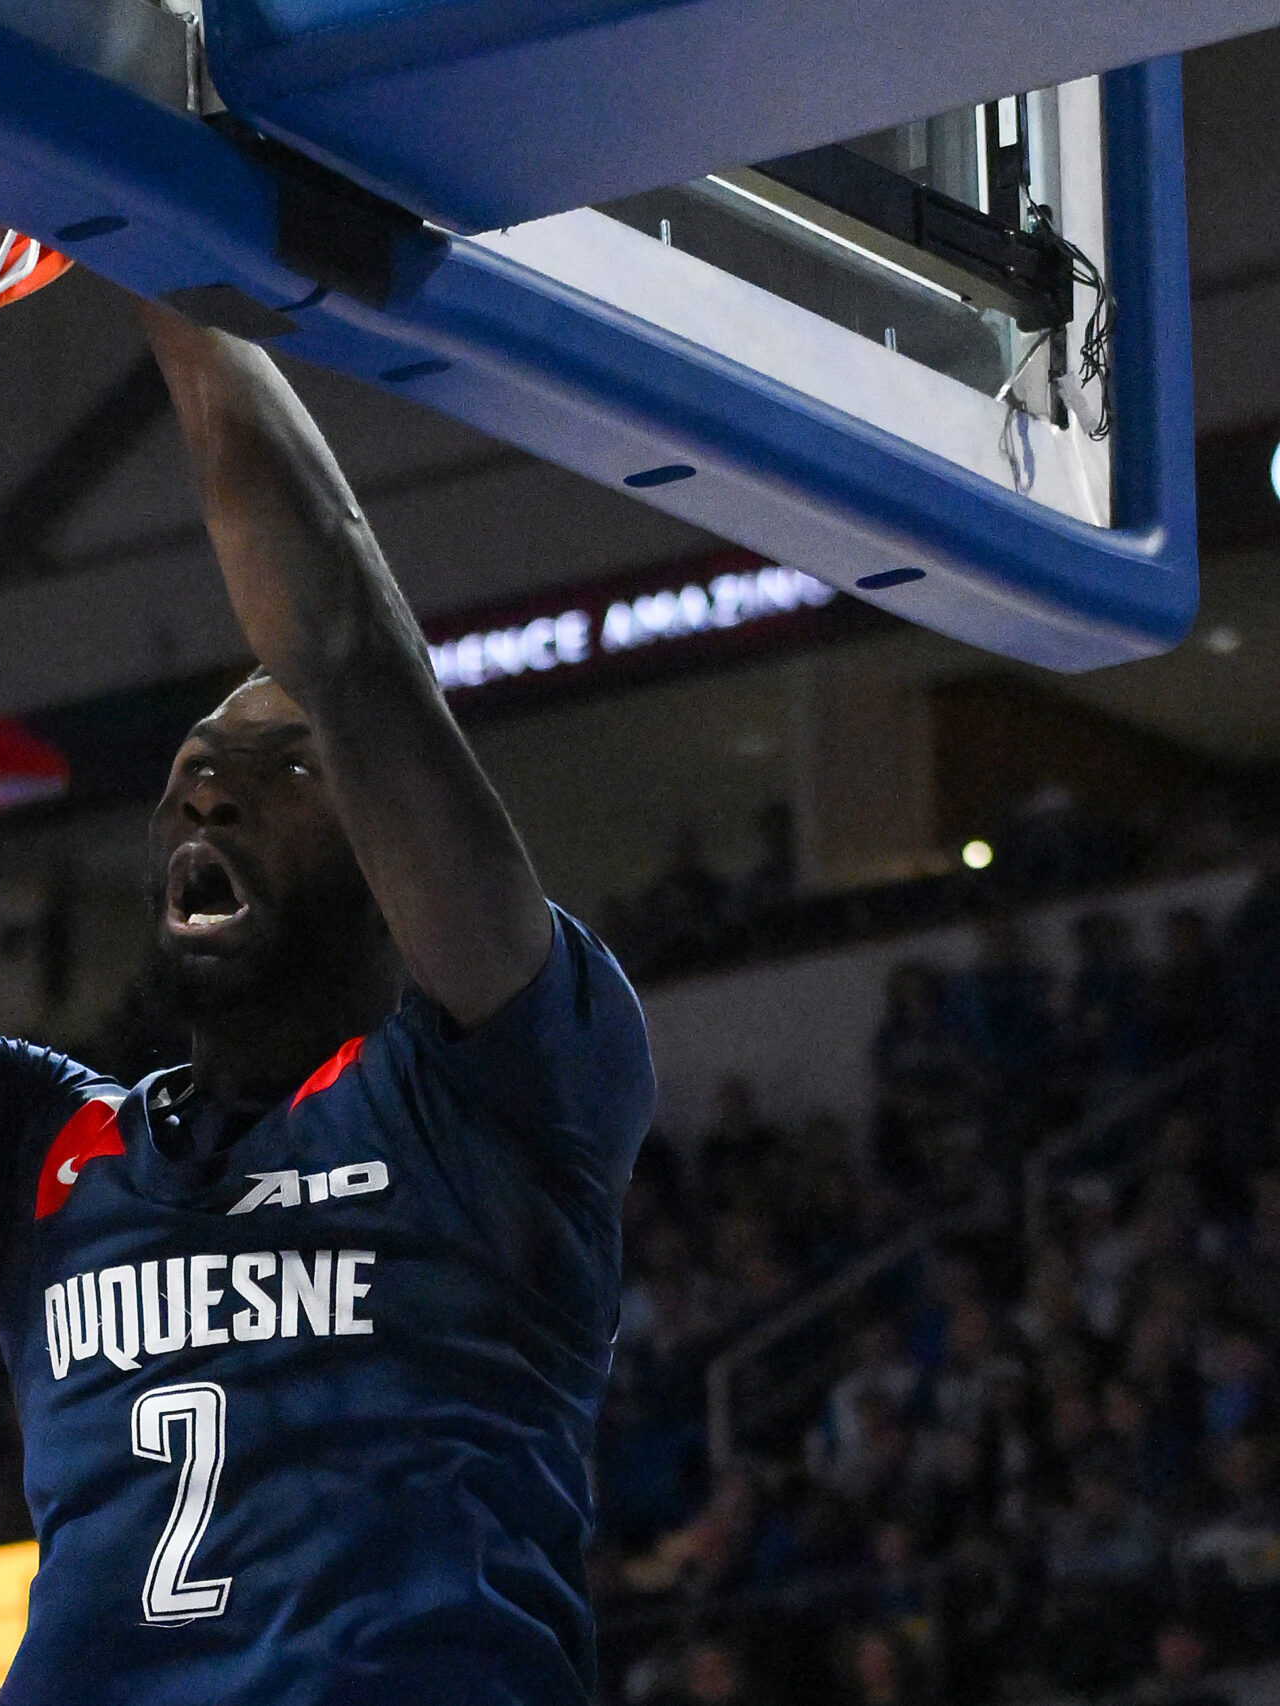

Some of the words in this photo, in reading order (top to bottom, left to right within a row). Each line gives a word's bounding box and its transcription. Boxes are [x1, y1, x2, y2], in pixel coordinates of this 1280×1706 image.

[429, 609, 590, 690] IENCE
[226, 1160, 390, 1216] A10
[44, 1249, 376, 1380] DUQUESNE
[131, 1381, 232, 1622] 2
